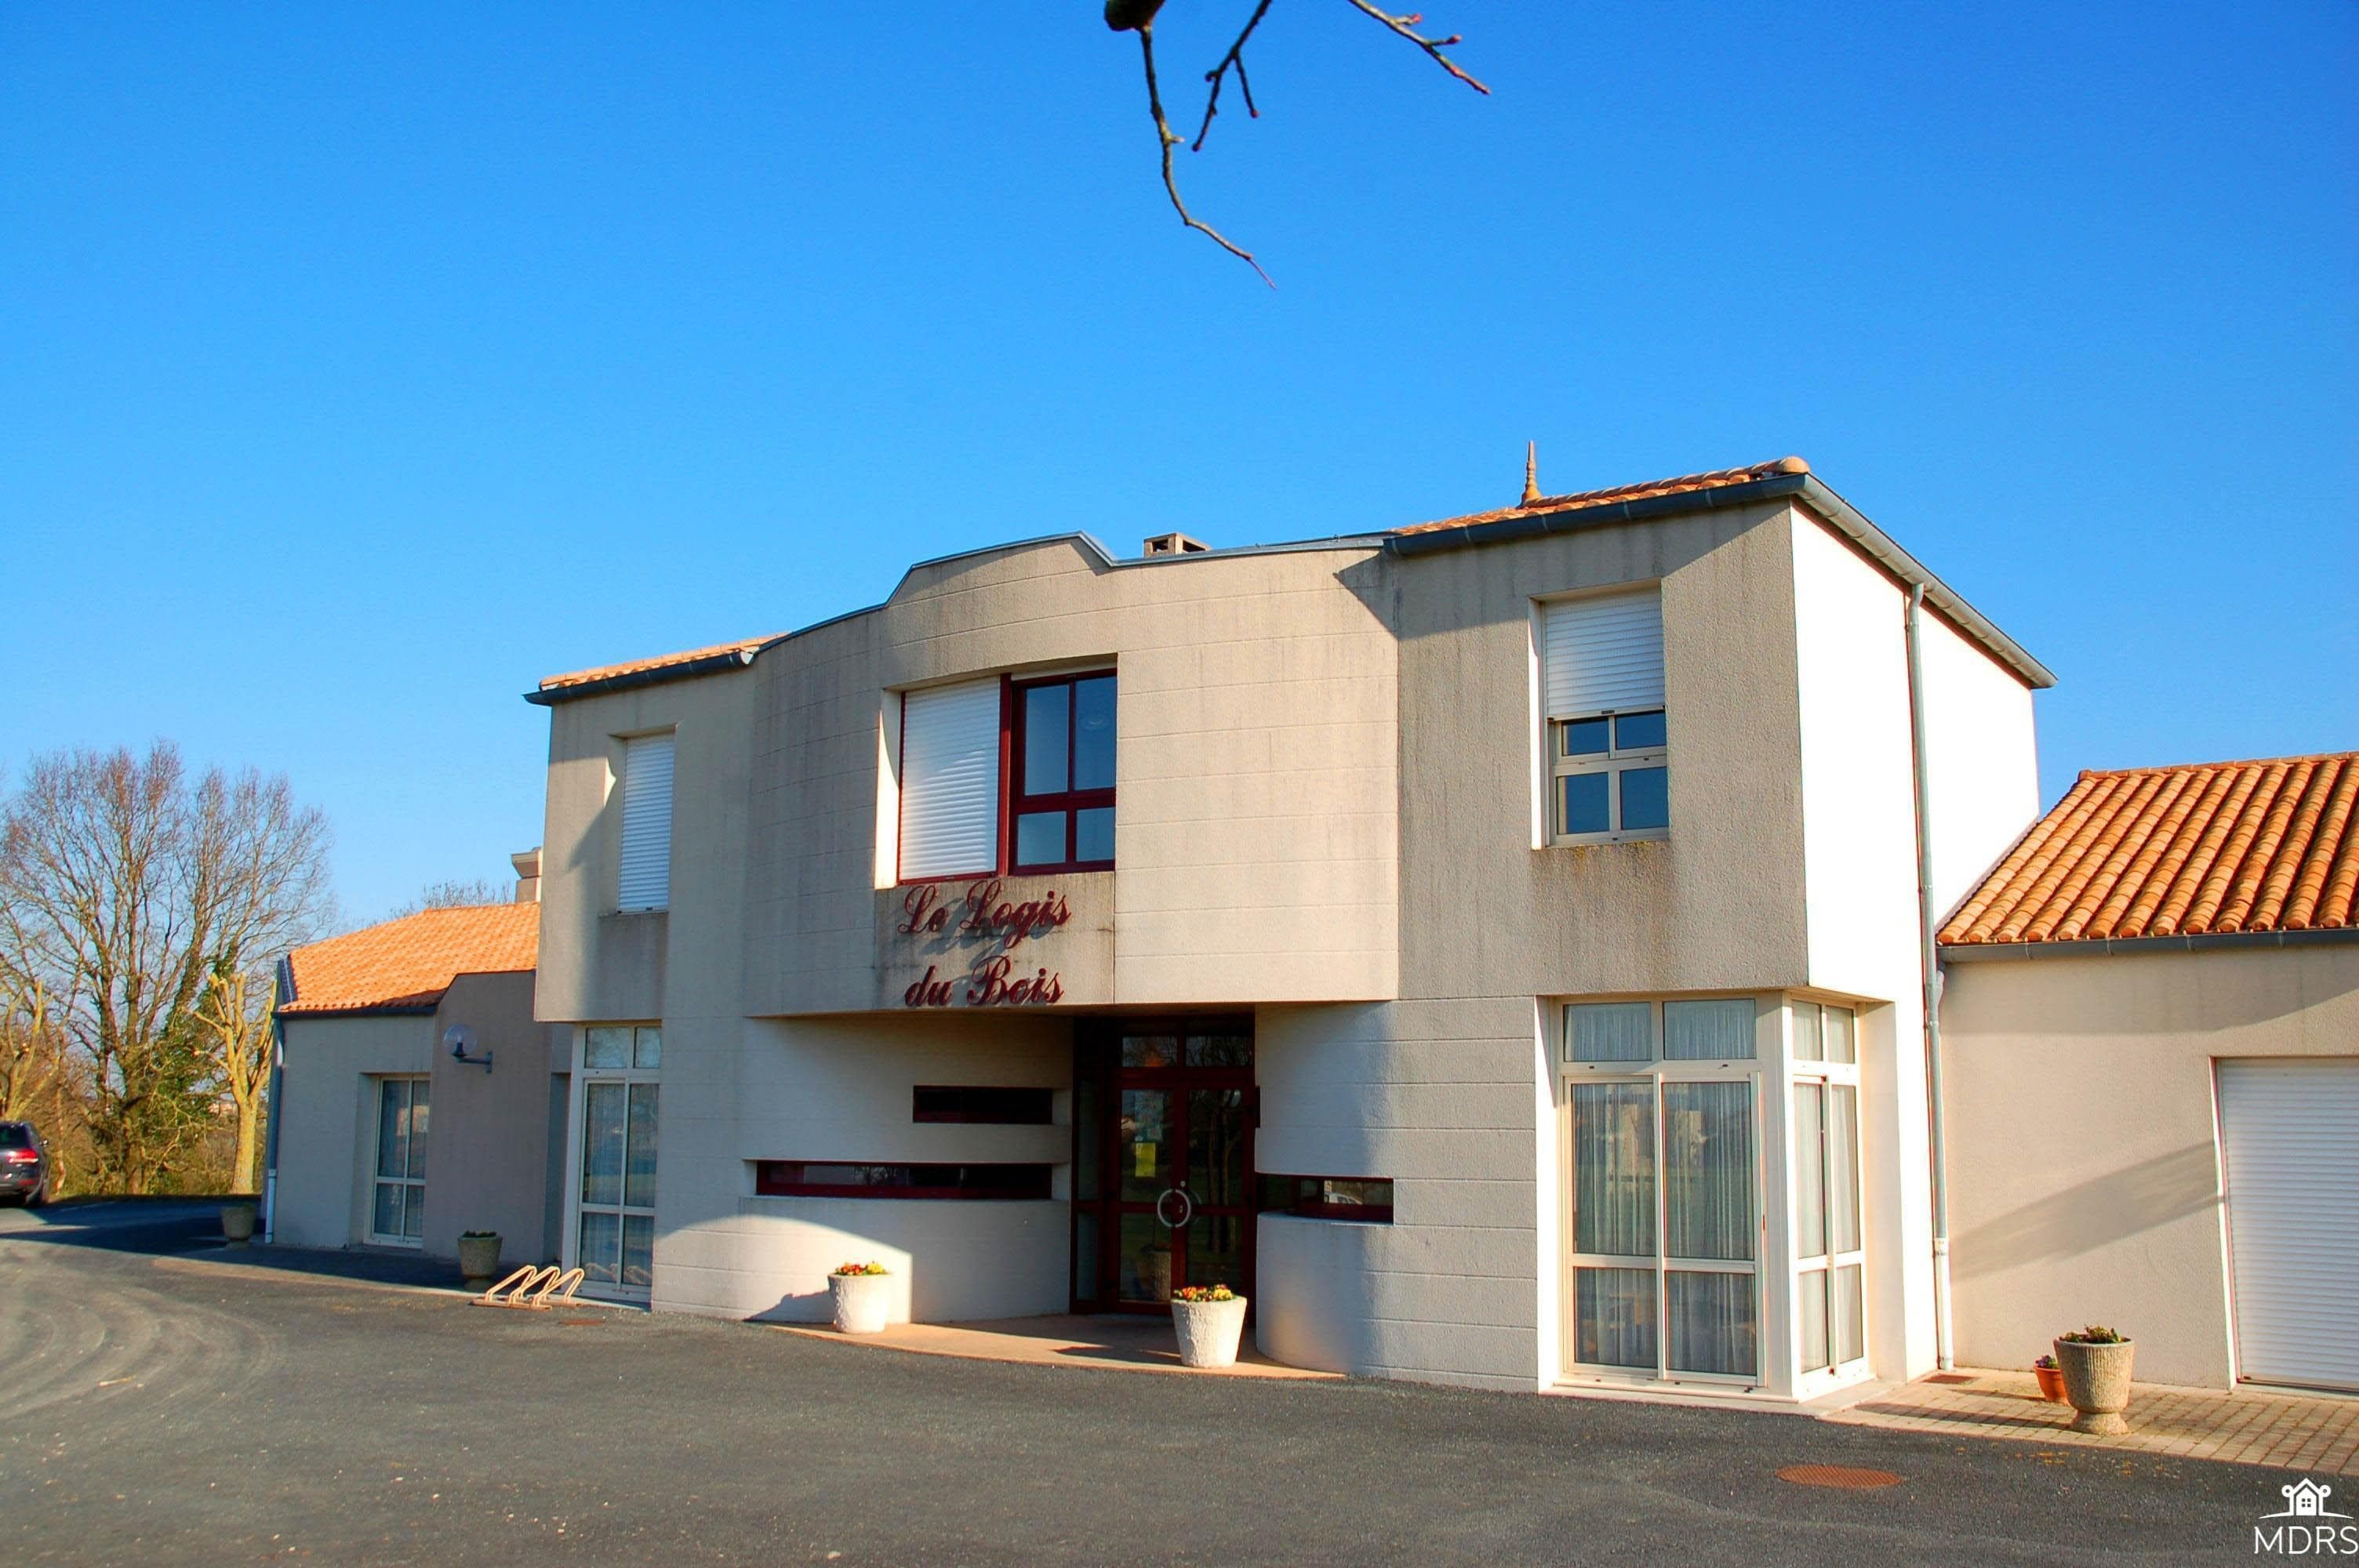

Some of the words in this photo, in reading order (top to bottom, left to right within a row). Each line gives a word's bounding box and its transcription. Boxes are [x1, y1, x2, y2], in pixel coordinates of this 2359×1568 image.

[898, 885, 949, 934] Le
[960, 880, 1071, 949] Logis
[904, 965, 954, 1006] du
[966, 955, 1065, 1005] Bois
